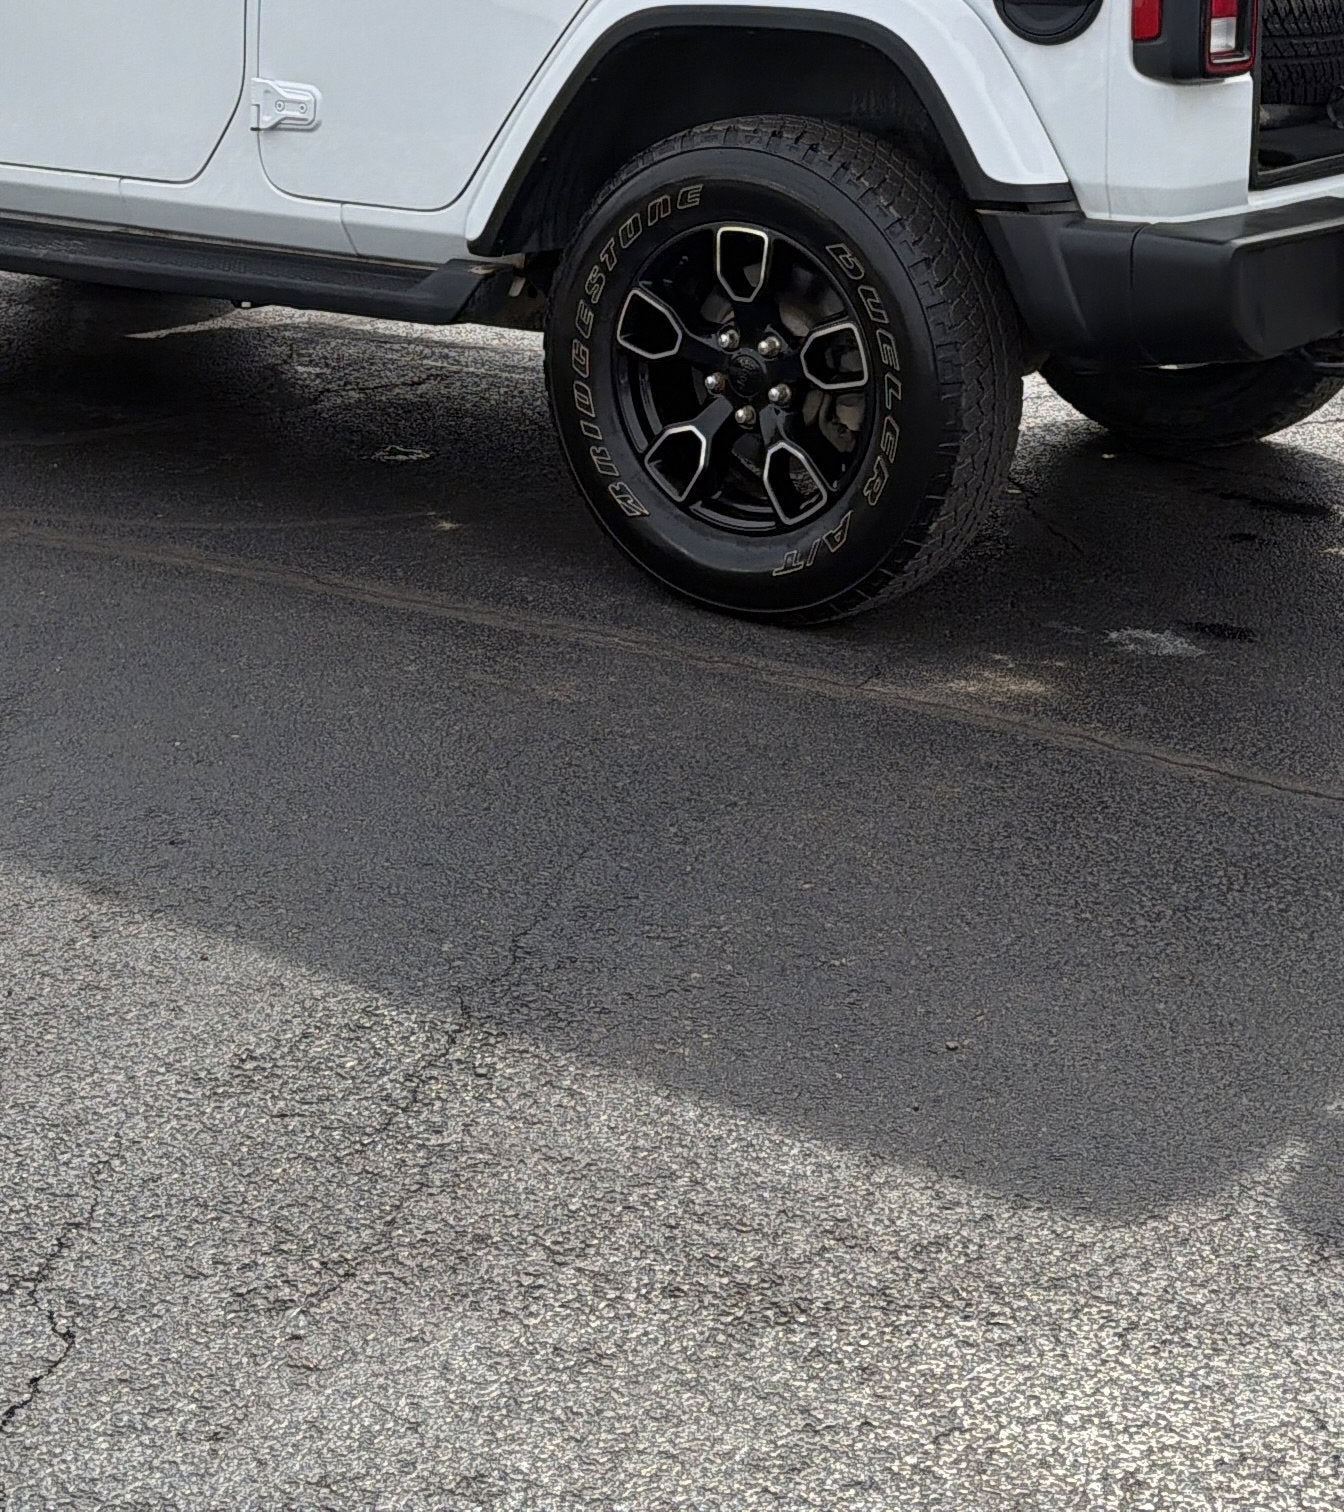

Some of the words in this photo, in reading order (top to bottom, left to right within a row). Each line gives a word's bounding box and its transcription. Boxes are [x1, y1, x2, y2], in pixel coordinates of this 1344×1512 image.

[573, 185, 703, 517] BRIDGESTONE
[825, 243, 902, 506] DUELER
[772, 510, 854, 576] A/T
